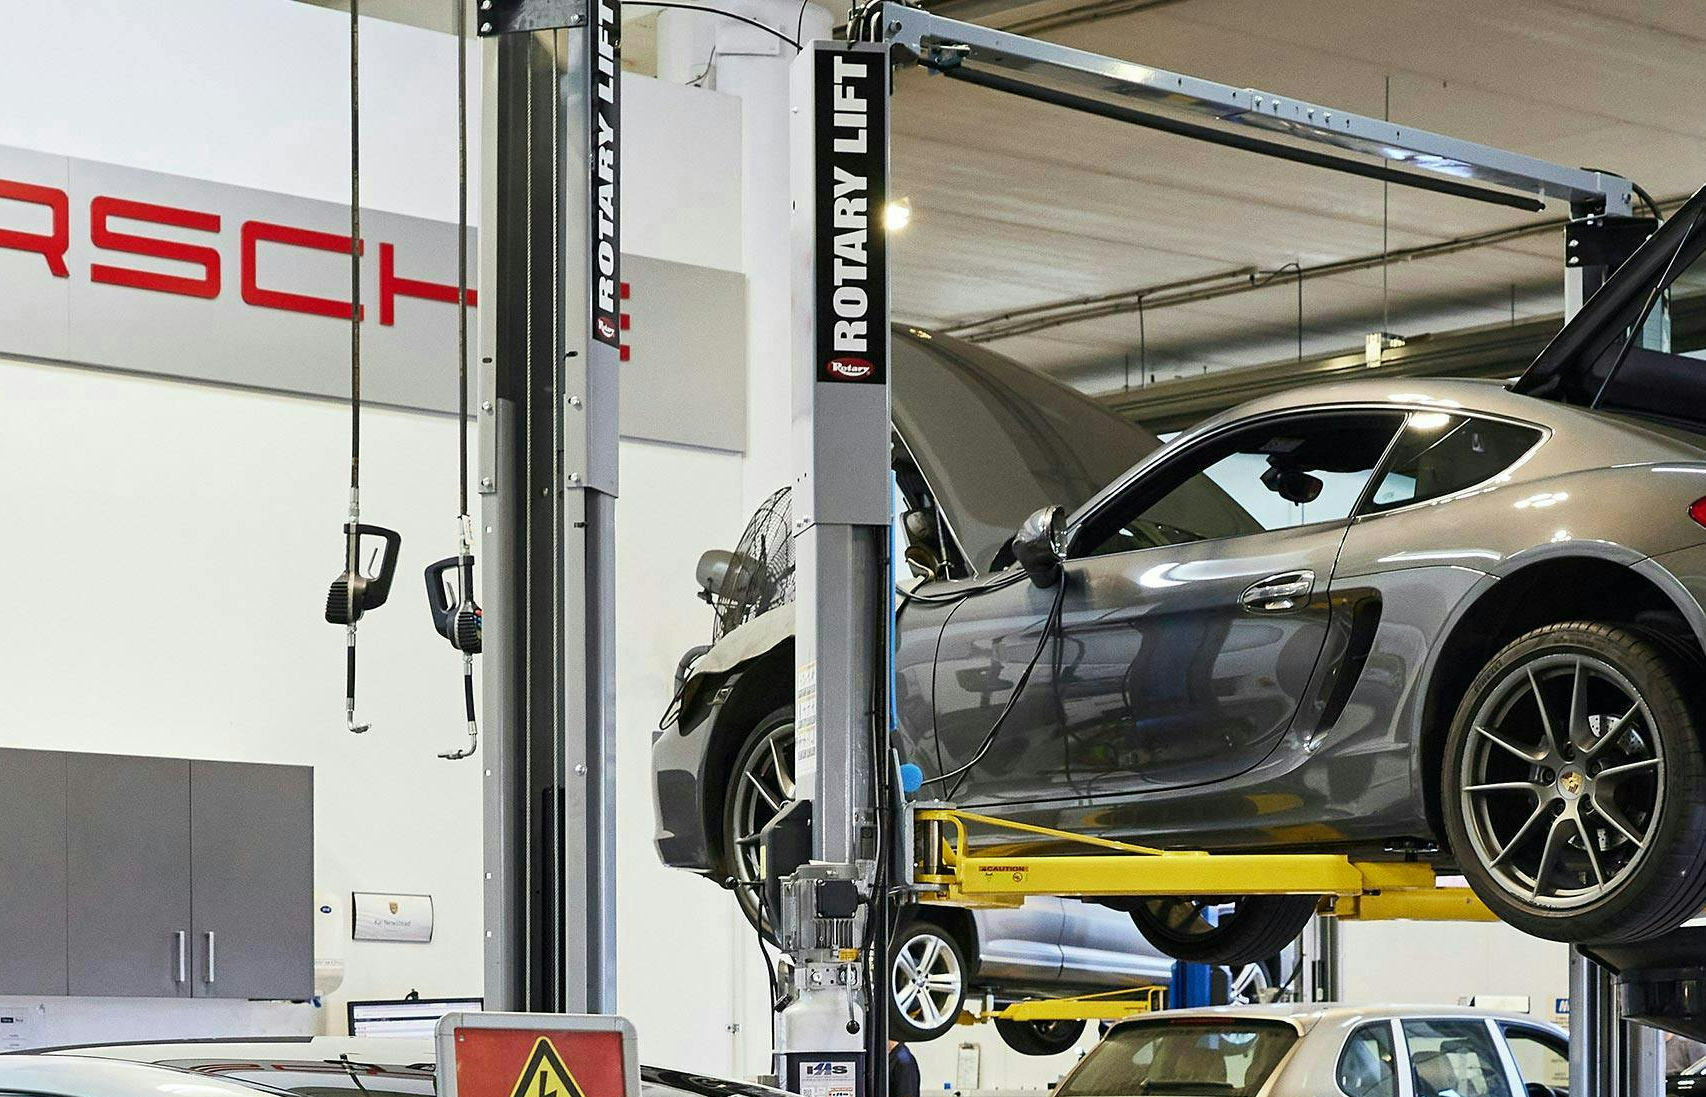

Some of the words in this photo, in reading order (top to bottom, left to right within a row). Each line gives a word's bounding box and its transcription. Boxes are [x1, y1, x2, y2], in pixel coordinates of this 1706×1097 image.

[597, 0, 615, 104] LIFT
[833, 55, 868, 154] LIFT
[597, 112, 615, 313] ROTARY
[833, 166, 868, 352] ROTARY
[830, 361, 872, 377] Rotary
